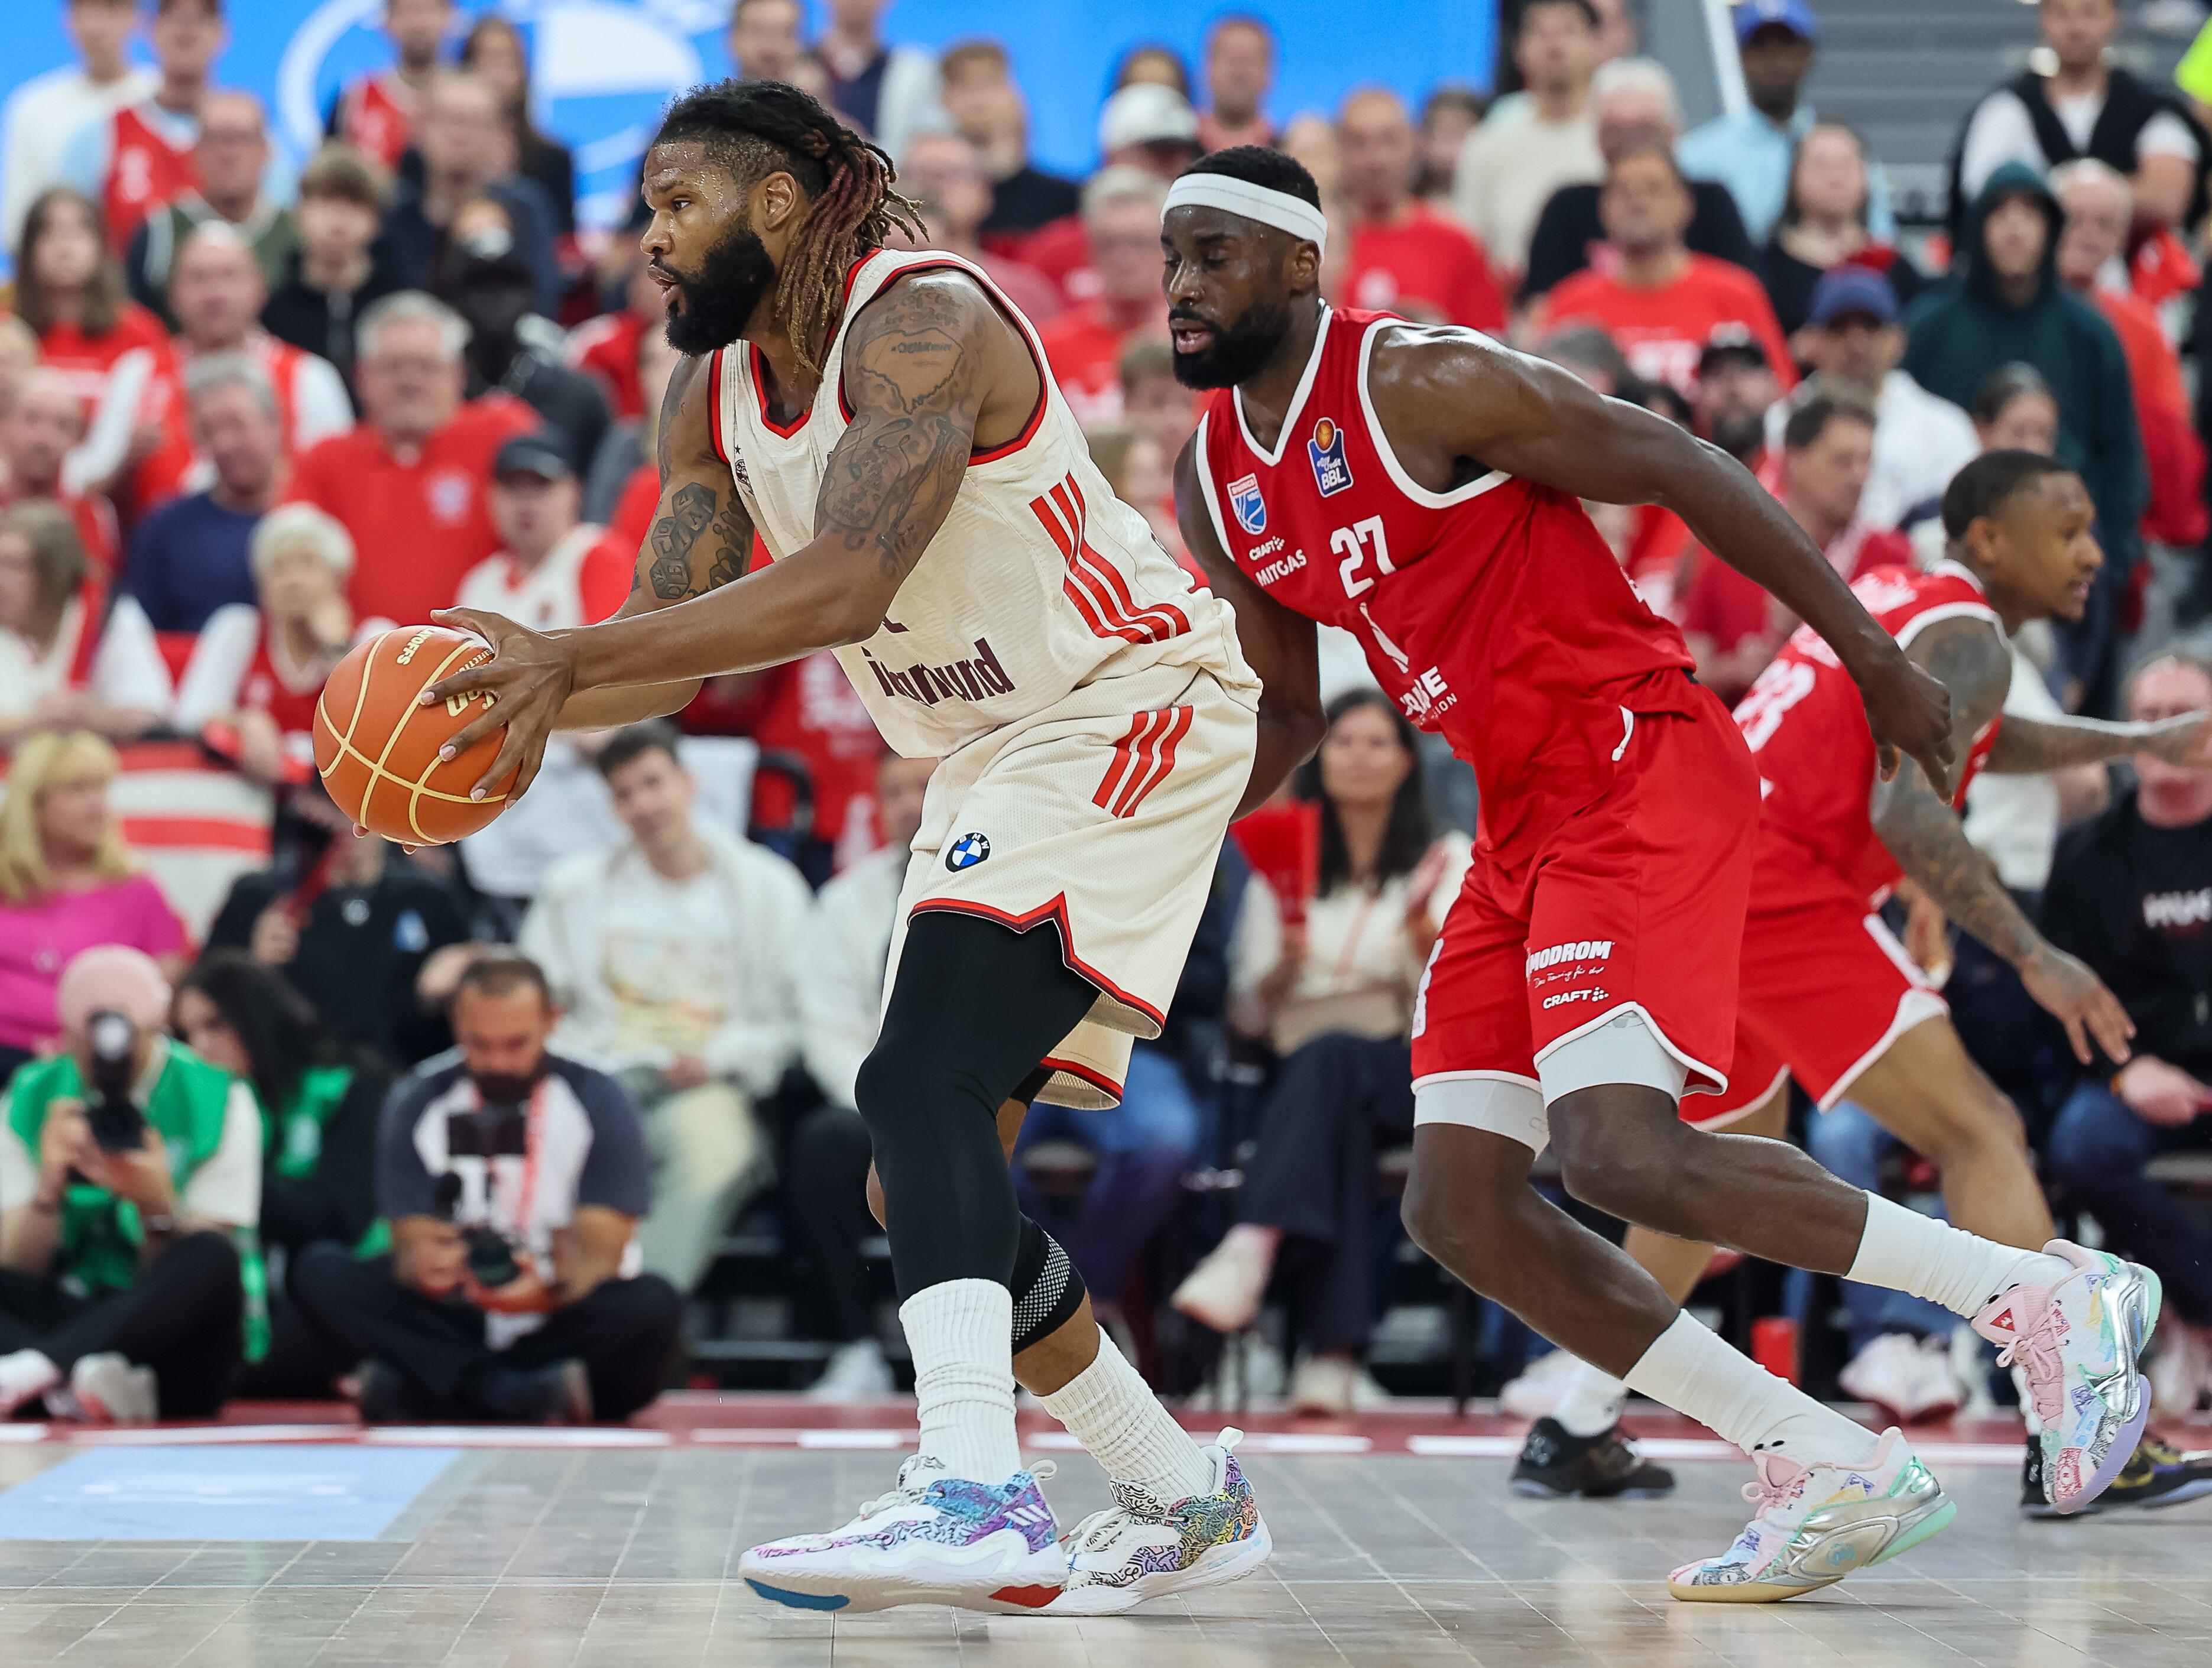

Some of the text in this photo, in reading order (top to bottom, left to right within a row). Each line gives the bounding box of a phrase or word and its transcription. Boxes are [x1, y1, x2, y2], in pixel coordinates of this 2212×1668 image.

[1321, 467, 1347, 490] BBL
[1255, 549, 1308, 586] MITGAS
[1329, 514, 1396, 599] 27
[1526, 941, 1612, 977] MODROM
[1543, 989, 1592, 1009] CRAFT
